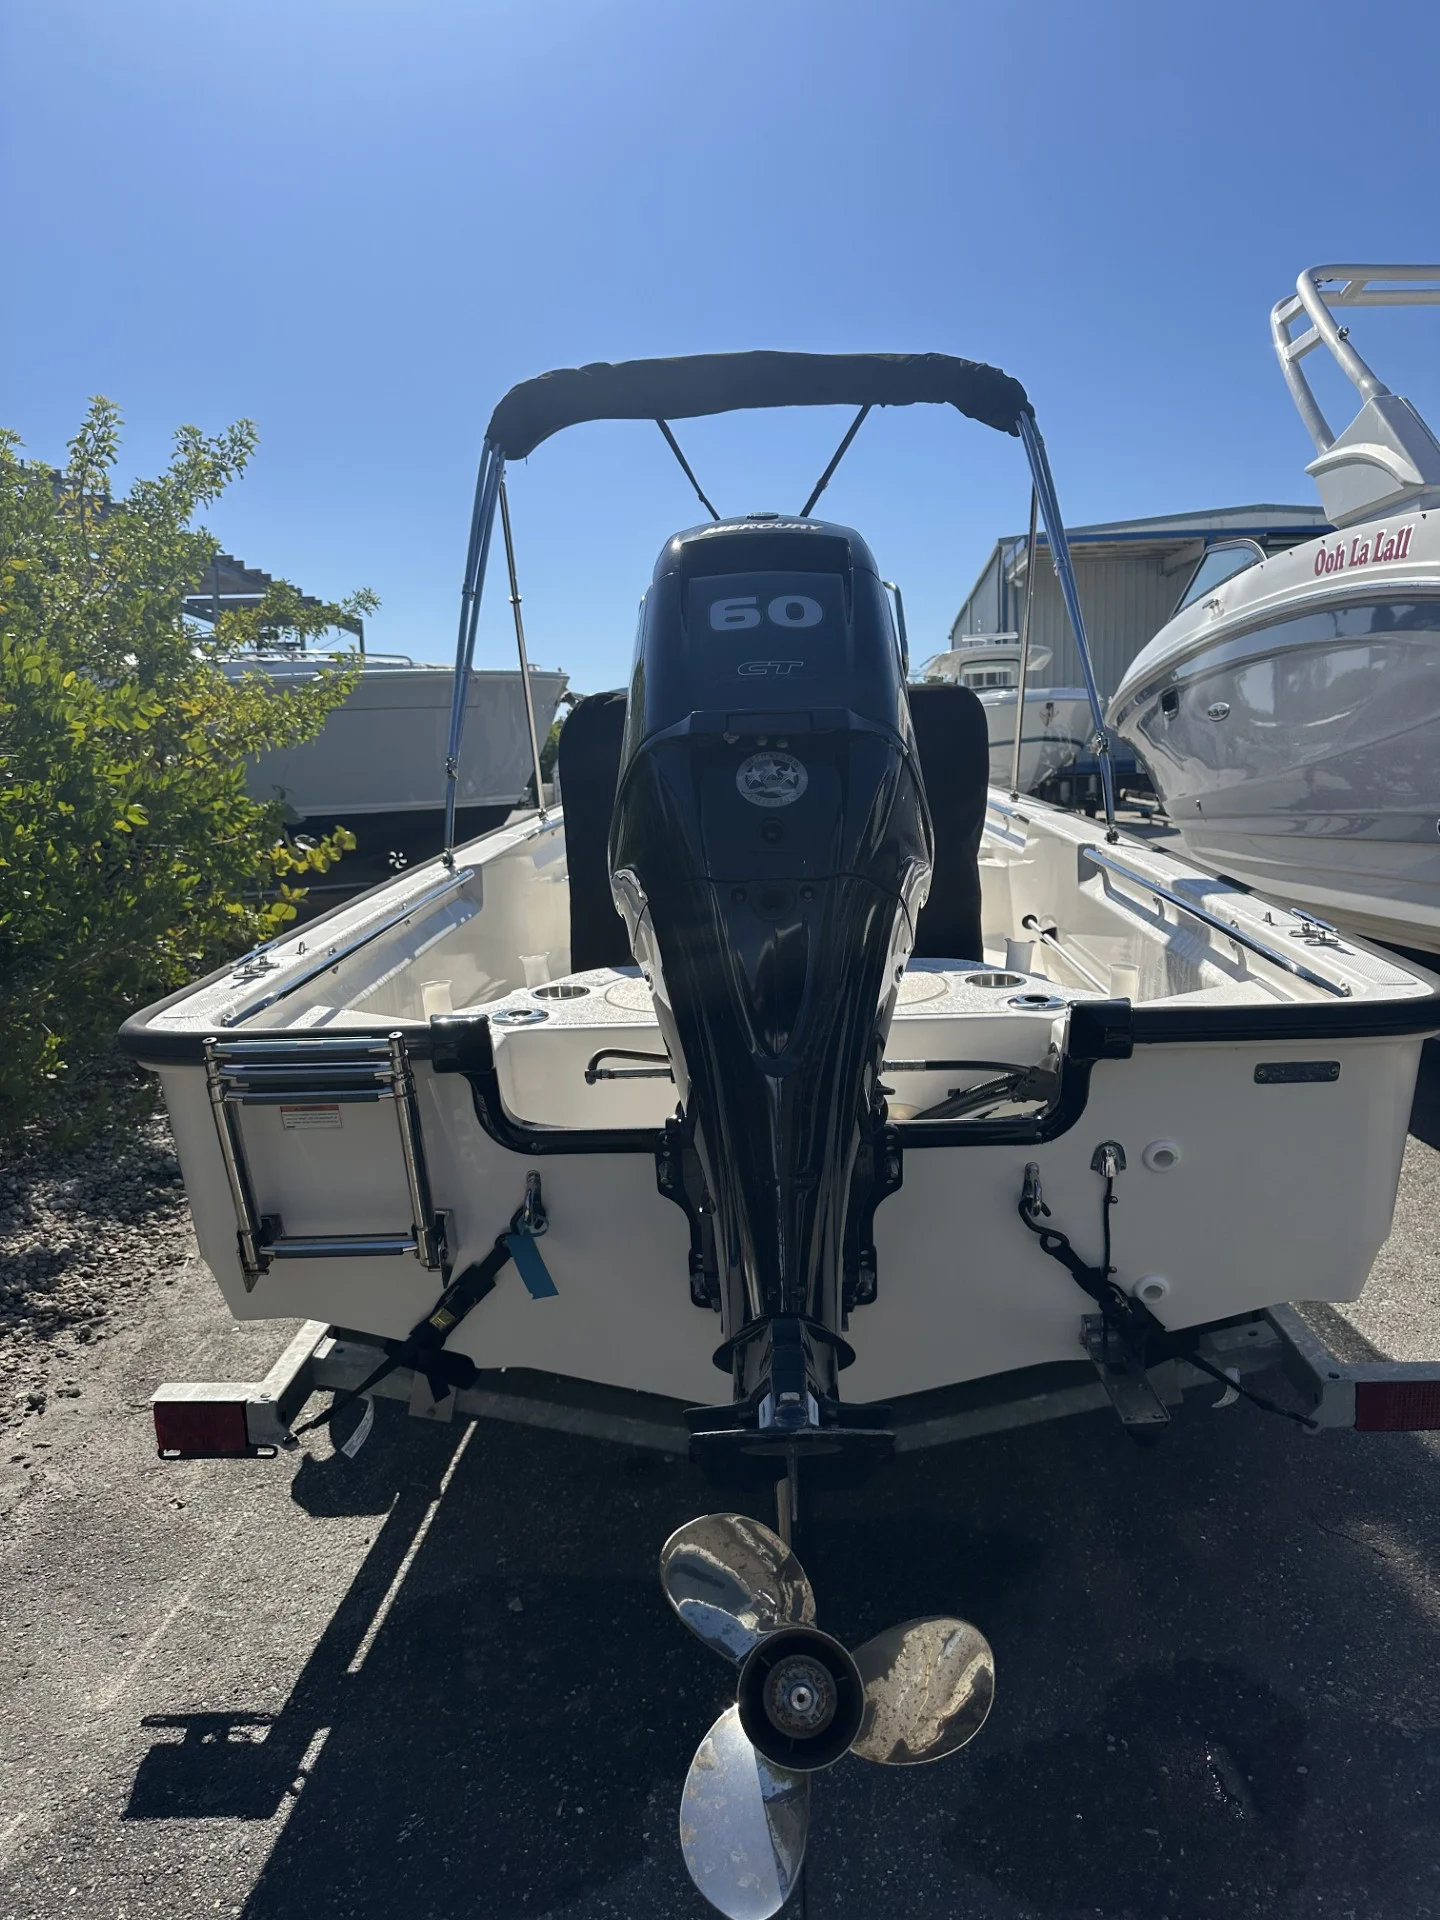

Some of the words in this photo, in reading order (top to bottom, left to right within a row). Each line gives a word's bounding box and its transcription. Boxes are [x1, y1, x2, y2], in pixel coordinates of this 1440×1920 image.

[700, 522, 823, 536] MERCURY
[1314, 541, 1346, 577] Ooh
[1348, 535, 1371, 567] La
[1372, 525, 1414, 563] Lall
[709, 595, 823, 631] 60
[737, 660, 804, 676] GT
